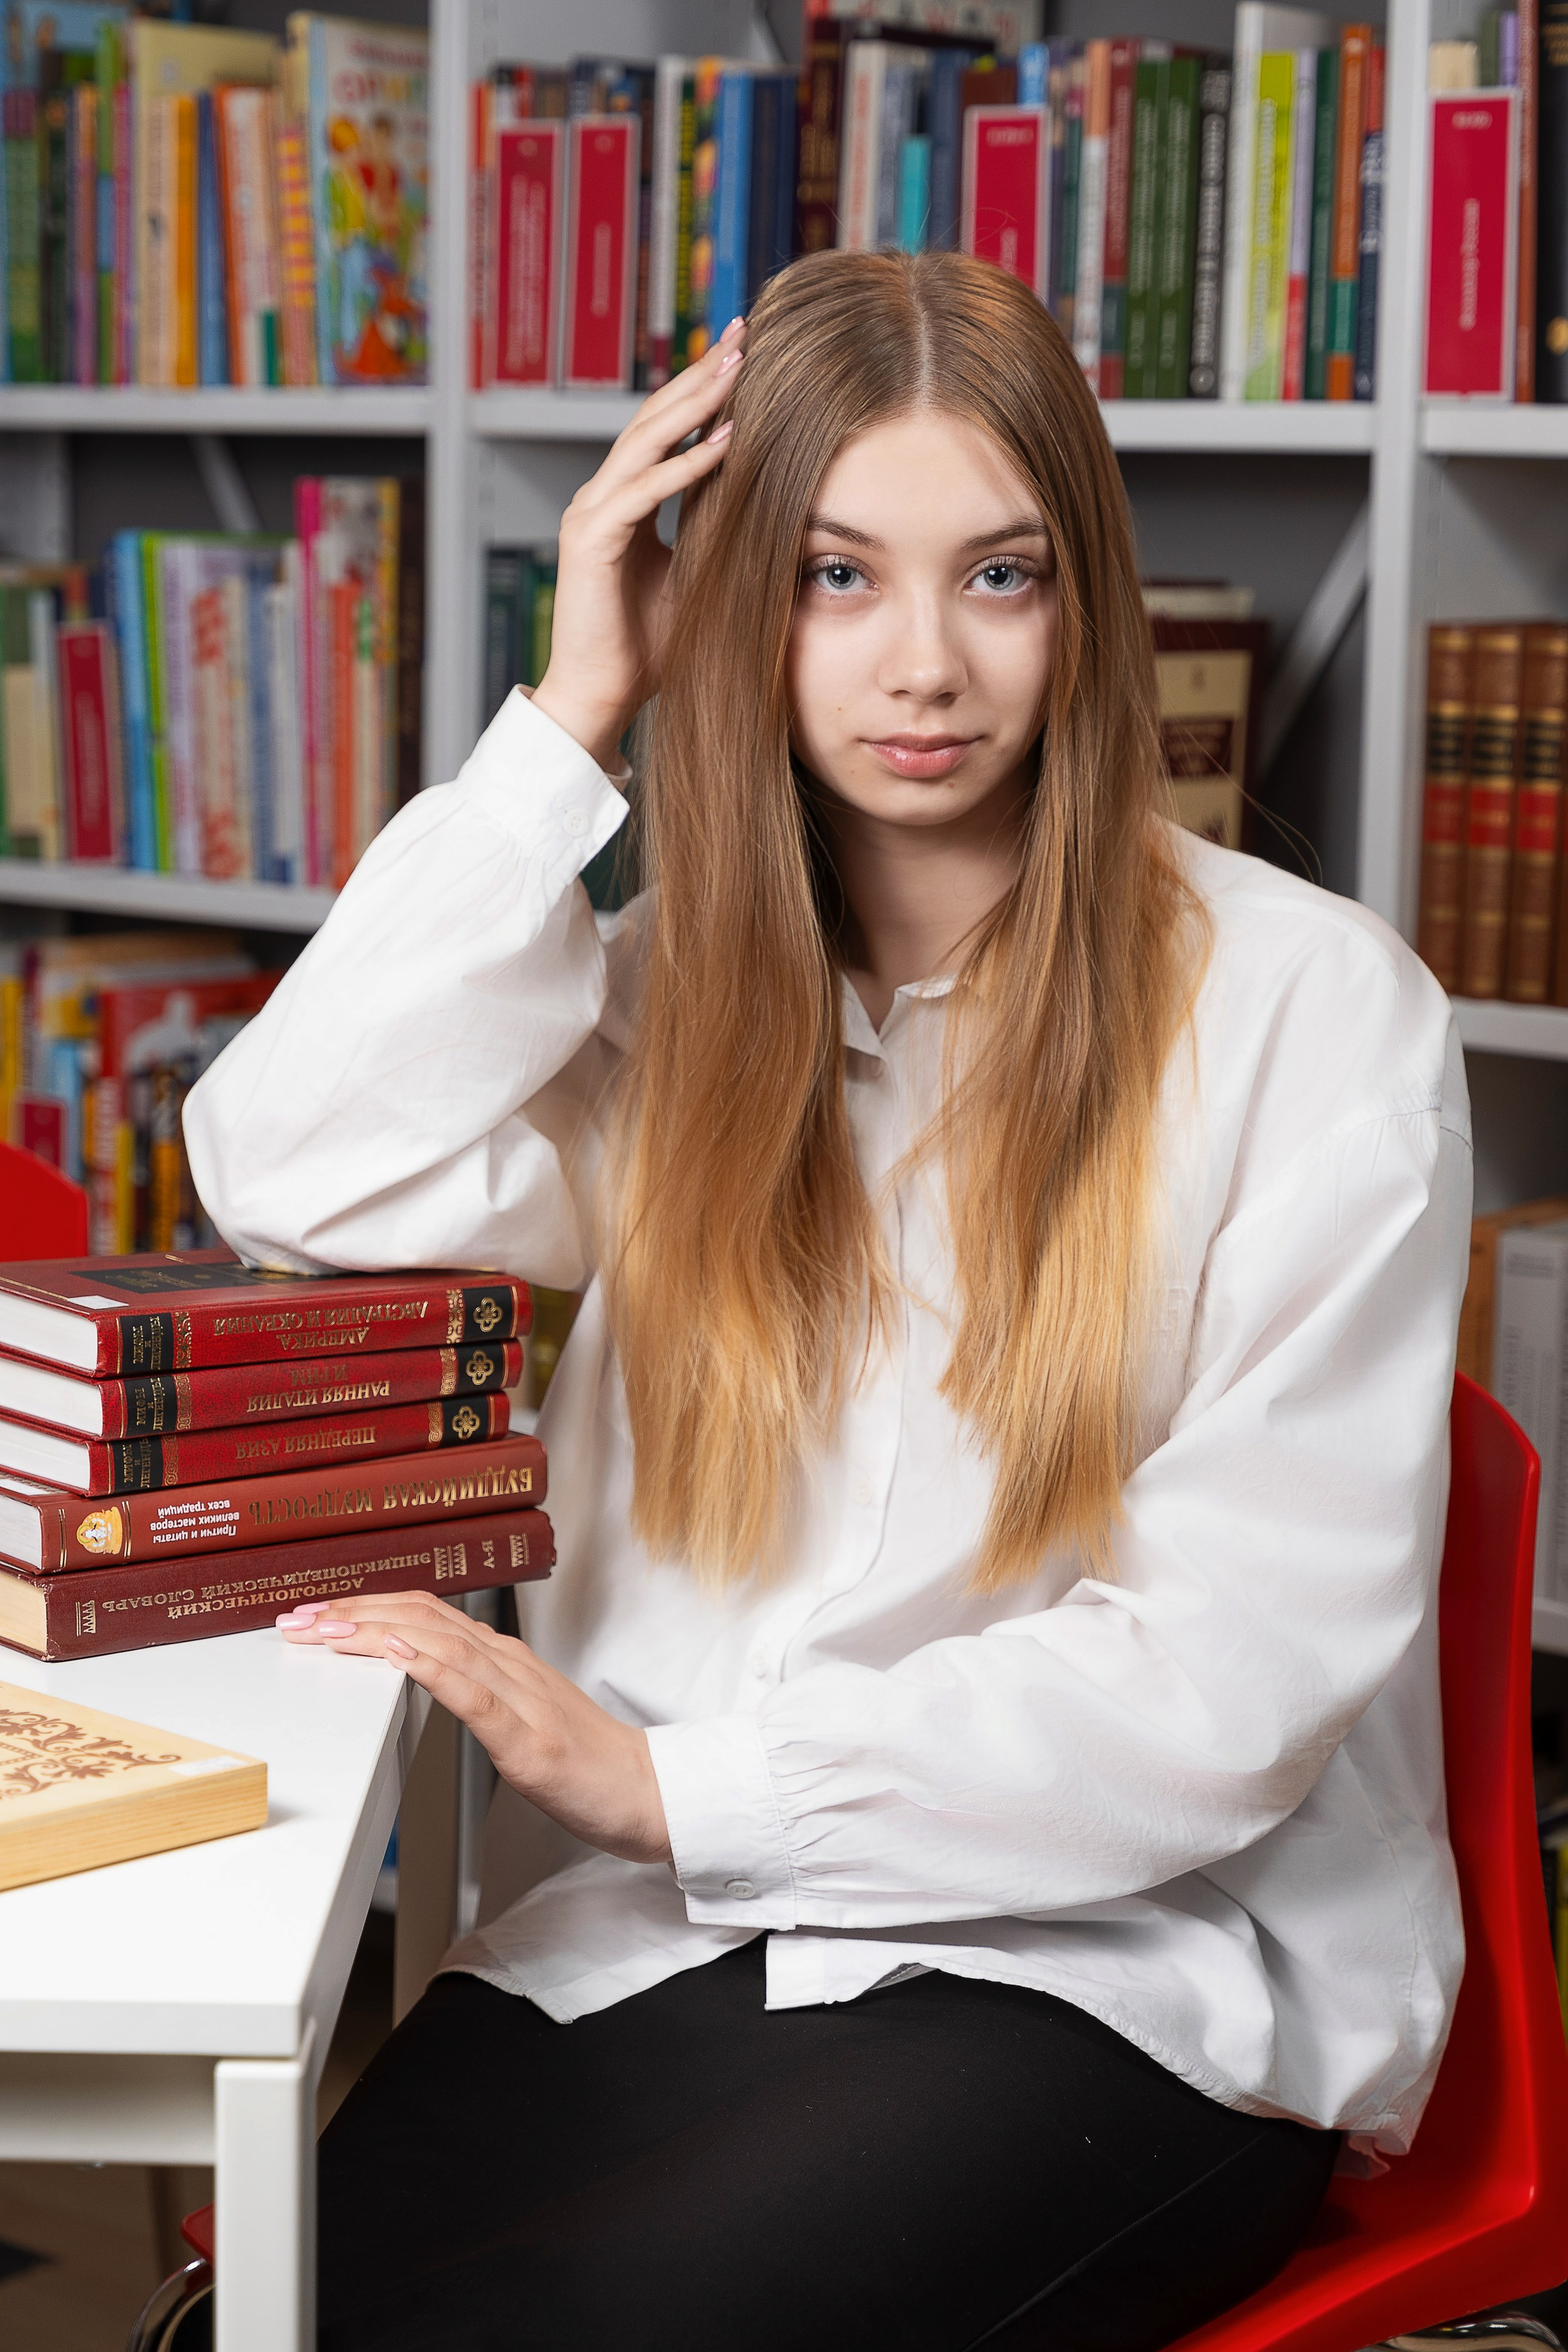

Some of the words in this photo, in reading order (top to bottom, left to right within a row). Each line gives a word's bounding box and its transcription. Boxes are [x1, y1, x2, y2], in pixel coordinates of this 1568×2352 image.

[213, 1312, 303, 1336] ОКЕАНИЯ
[307, 1310, 321, 1327] И
[326, 1300, 428, 1326] АВСТРАЛИЯ
[289, 1367, 330, 1386] РИМ
[333, 1364, 347, 1381] И
[246, 1388, 318, 1412] ИТАЛИЯ
[320, 1380, 390, 1404] РАННЯЯ
[135, 1387, 146, 1425] МИФЫ
[151, 1378, 165, 1431] ЛЕГЕНДЫ
[235, 1439, 280, 1459] АЗИЯ
[284, 1426, 375, 1453] ПЕРЕДНЯЯ
[123, 1444, 133, 1483] МИФЫ
[382, 1464, 533, 1510] БУДДИЙСКАЯ
[157, 1501, 206, 1519] традиций
[207, 1499, 231, 1510] всех
[248, 1487, 373, 1526] МУДРОСТЬ
[149, 1517, 197, 1531] мастеров
[198, 1512, 240, 1525] великих
[200, 1524, 236, 1537] Притчи
[153, 1530, 189, 1544] цитаты
[482, 1539, 496, 1569] А-Я
[200, 1551, 432, 1600] ЭНЦИКЛОПЕДИЧЕСКИЙ
[102, 1589, 195, 1612] СЛОВАРЬ
[167, 1577, 365, 1619] АСТРОЛОГИЧЕСКИЙ
